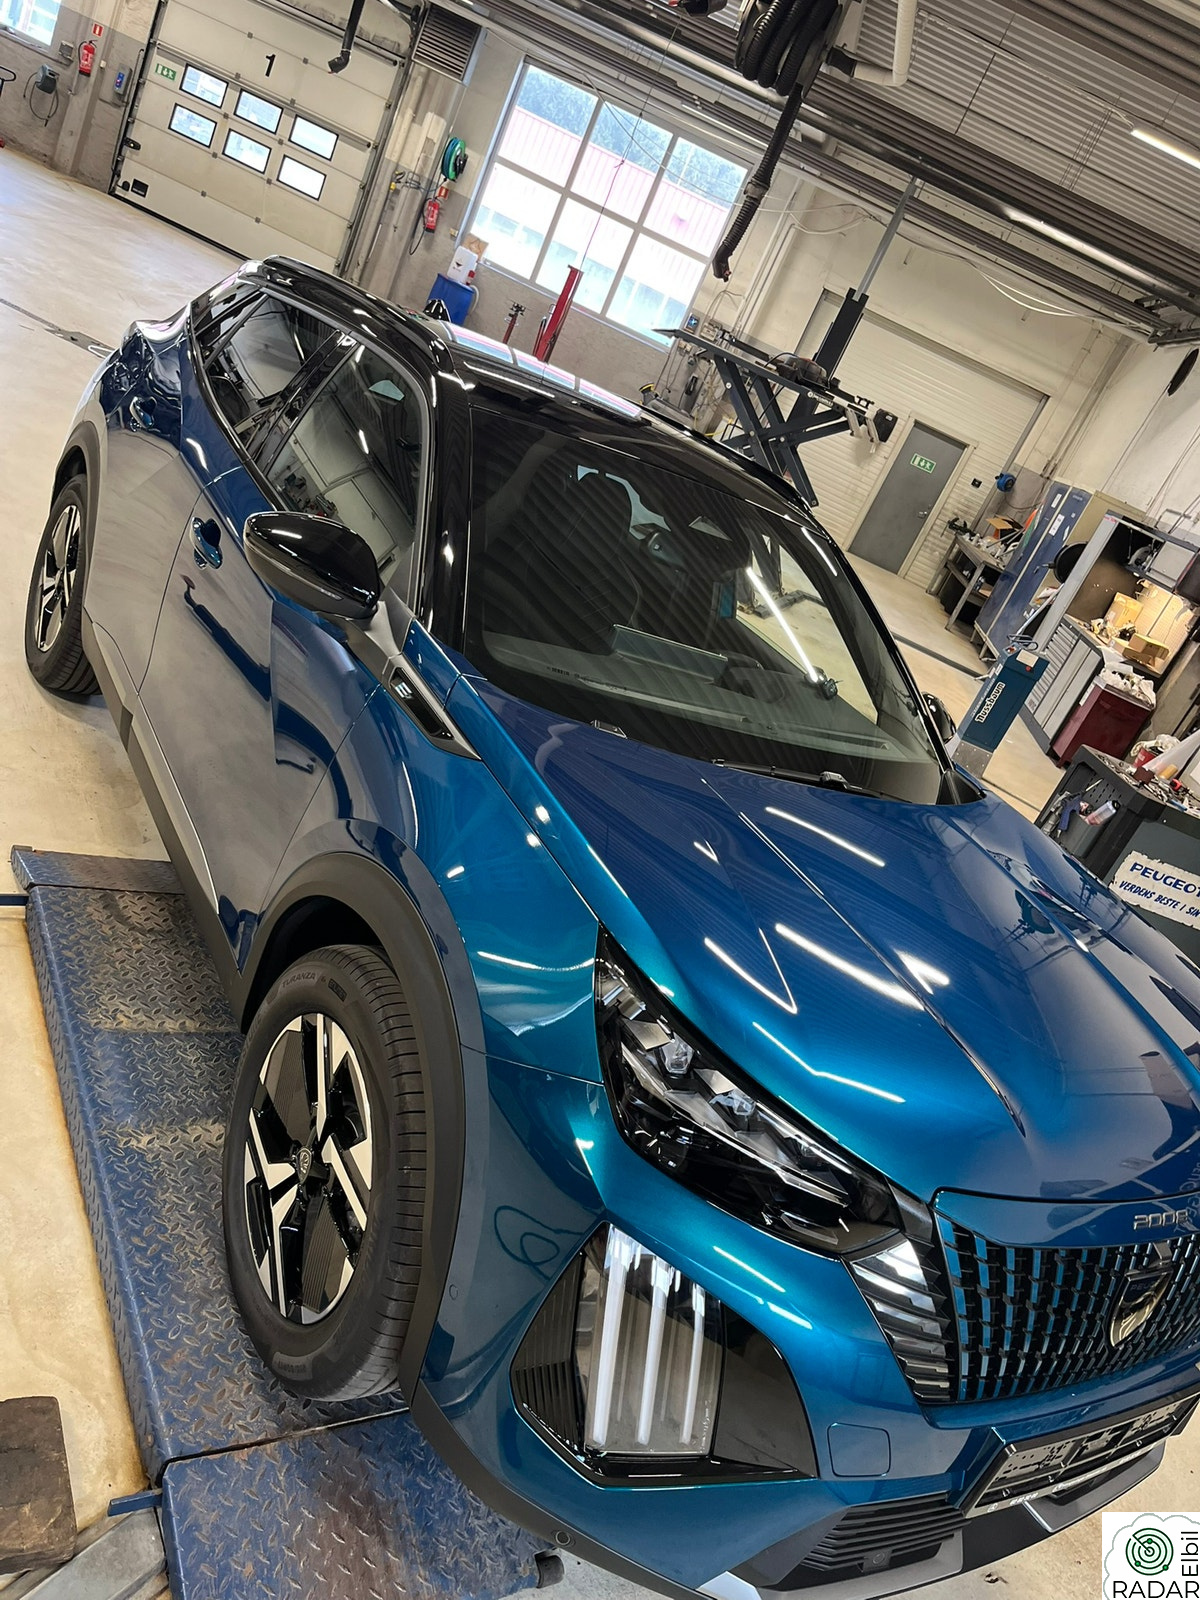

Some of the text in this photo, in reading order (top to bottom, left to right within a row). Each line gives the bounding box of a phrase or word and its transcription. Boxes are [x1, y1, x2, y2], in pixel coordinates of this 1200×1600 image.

[265, 53, 276, 77] 1
[1119, 880, 1156, 899] VERDENS
[1154, 894, 1181, 909] BESTE
